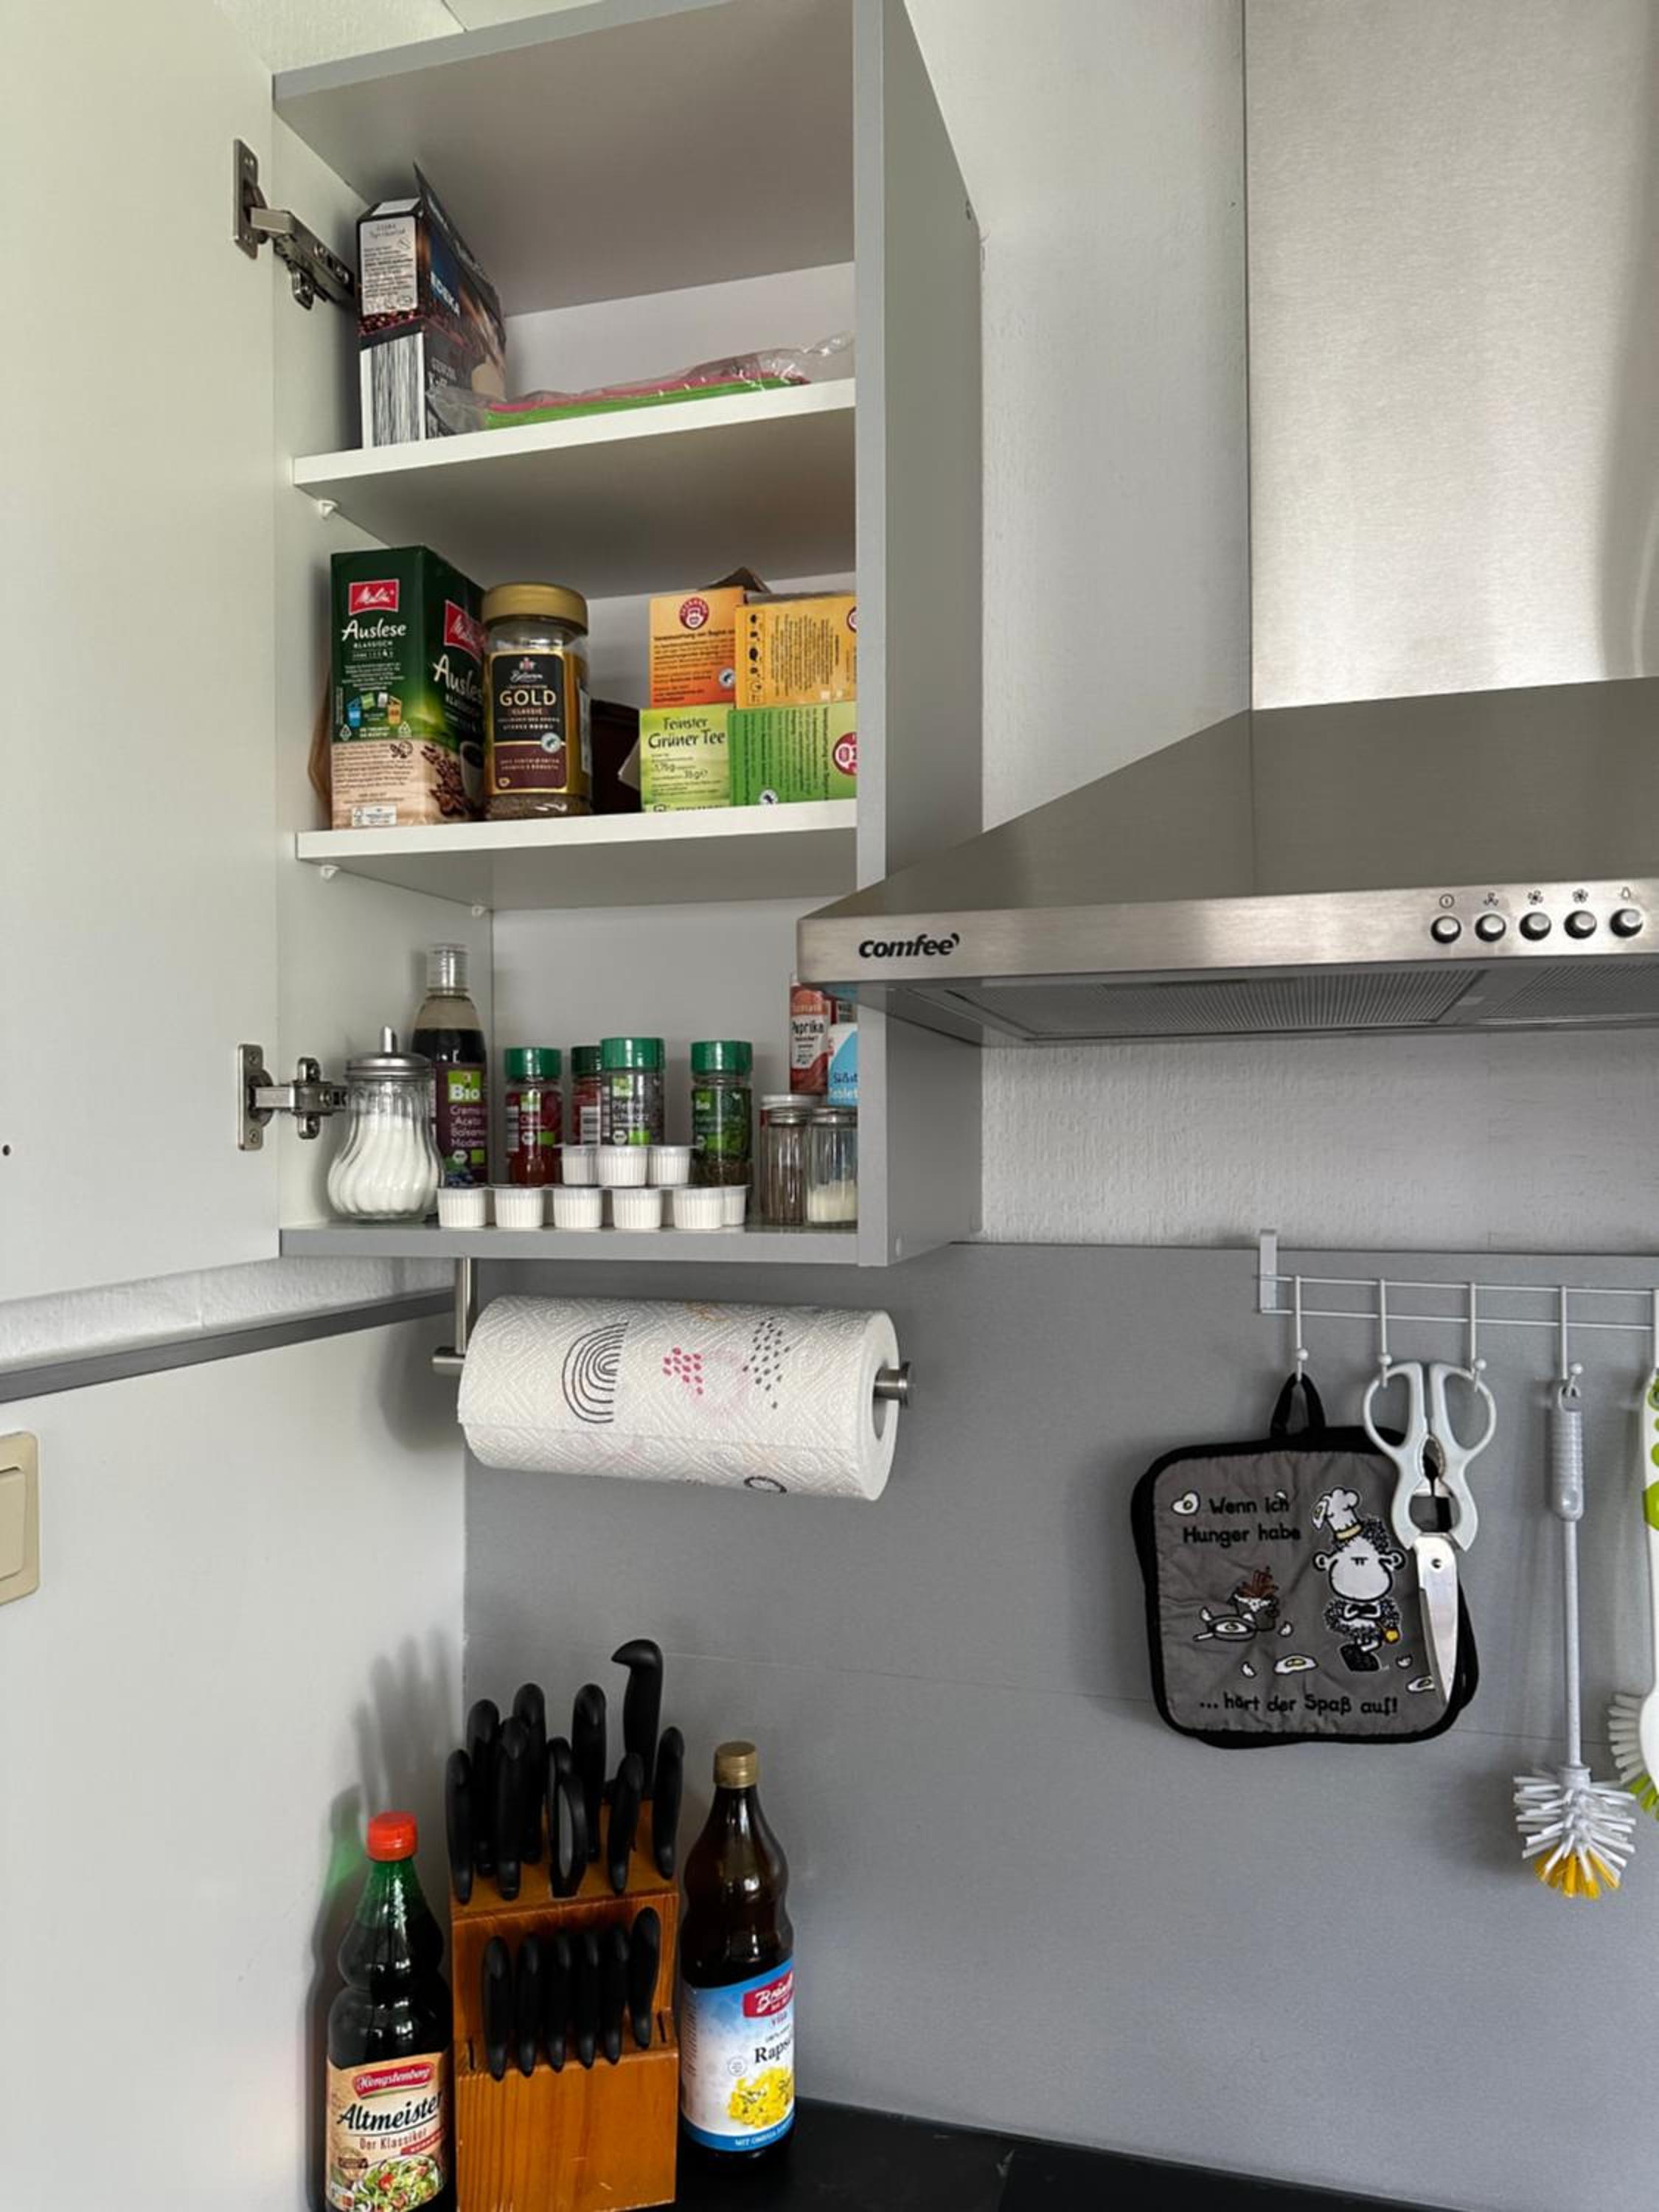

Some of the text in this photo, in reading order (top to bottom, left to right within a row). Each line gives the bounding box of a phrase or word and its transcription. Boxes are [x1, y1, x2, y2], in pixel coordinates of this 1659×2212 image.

[341, 617, 407, 641] Auslese
[499, 689, 557, 706] GOLD
[664, 717, 708, 731] Feinster
[648, 729, 726, 749] Grüner Tee
[450, 1084, 481, 1101] Bio
[1208, 1497, 1257, 1514] Wenn
[1183, 1522, 1301, 1548] Hunger habe
[1224, 1691, 1260, 1711] hört
[1267, 1695, 1296, 1712] der
[1304, 1693, 1352, 1717] Spaß
[1357, 1697, 1397, 1717] auf!
[336, 2090, 442, 2132] Altmeister
[359, 2138, 376, 2150] Der
[380, 2127, 428, 2149] Klassiker
